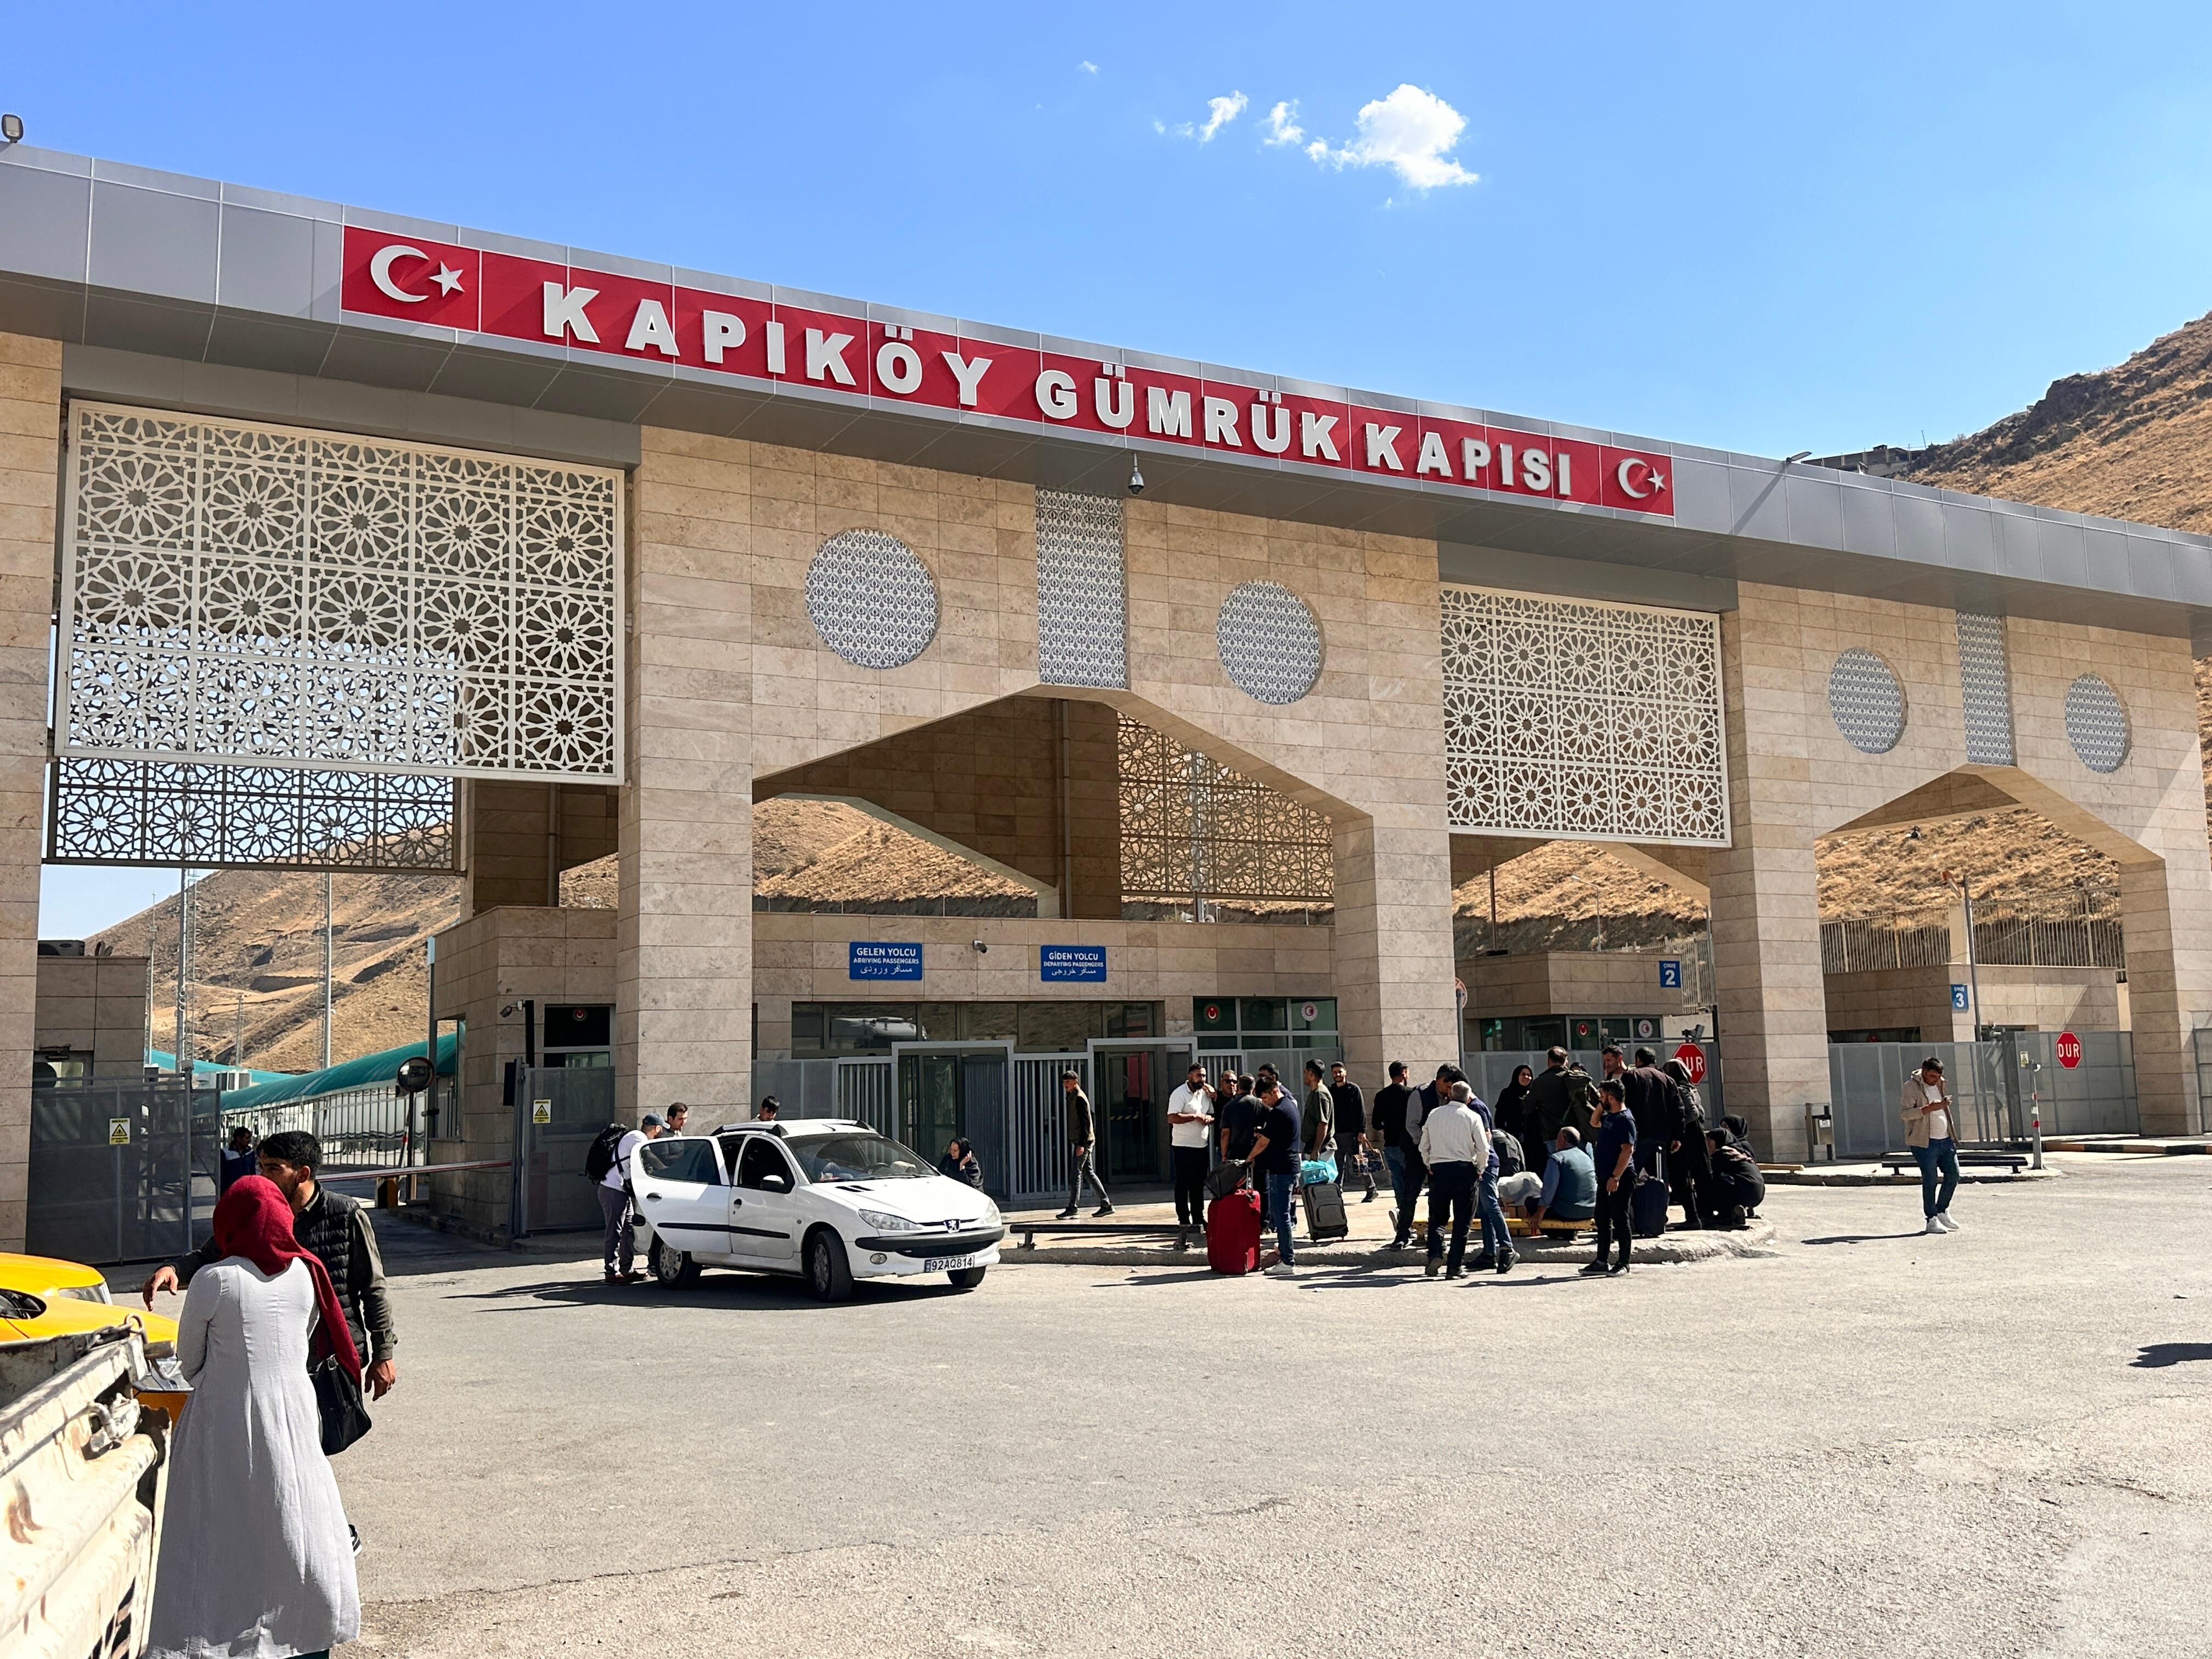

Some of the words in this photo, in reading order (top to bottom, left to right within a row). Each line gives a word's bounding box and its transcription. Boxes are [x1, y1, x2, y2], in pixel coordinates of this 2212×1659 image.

[543, 280, 994, 408] KAPIKÖY
[1035, 363, 1342, 462] GÜMRÜK
[1364, 422, 1572, 496] KAPISI
[856, 947, 885, 956] GELEN
[887, 948, 916, 956] YOLCU
[1049, 951, 1073, 960] GİDEN
[890, 964, 913, 975] مسافر
[1665, 969, 1675, 985] 2
[1955, 992, 1965, 1008] 3
[2058, 1043, 2080, 1058] DUR
[1676, 1057, 1703, 1072] UR
[932, 1257, 973, 1271] 92AQ814
